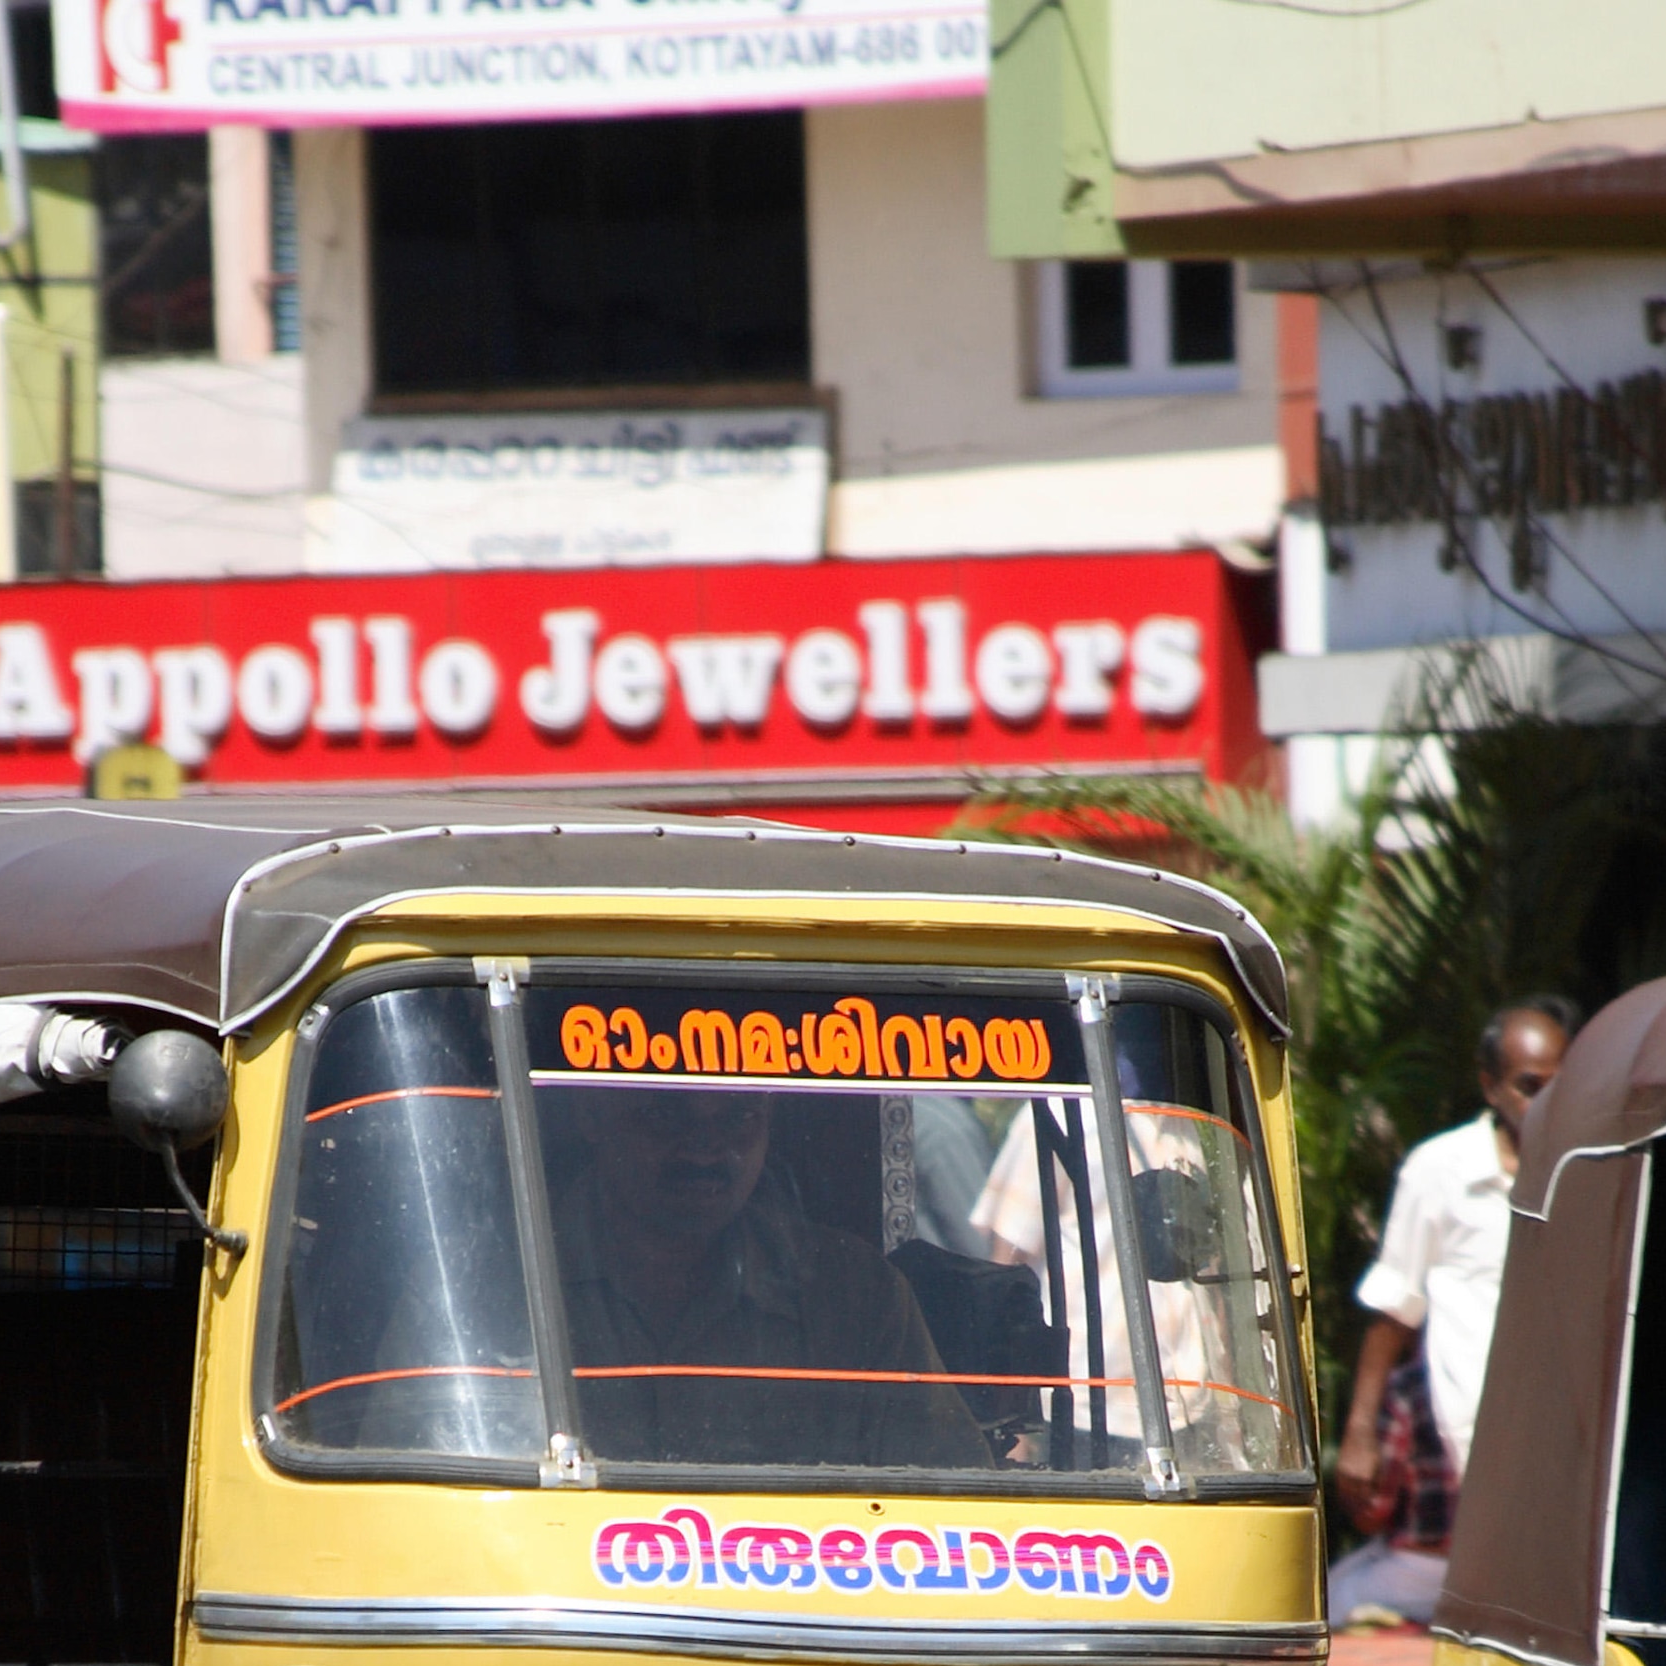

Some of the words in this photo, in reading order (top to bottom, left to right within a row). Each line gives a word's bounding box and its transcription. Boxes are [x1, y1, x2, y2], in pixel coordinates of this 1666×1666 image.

[208, 54, 389, 95] CENTRAL
[402, 43, 610, 87] JUNCTION,
[519, 597, 1204, 732] Jewellers
[593, 1506, 1172, 1602] തിരുവോണം
